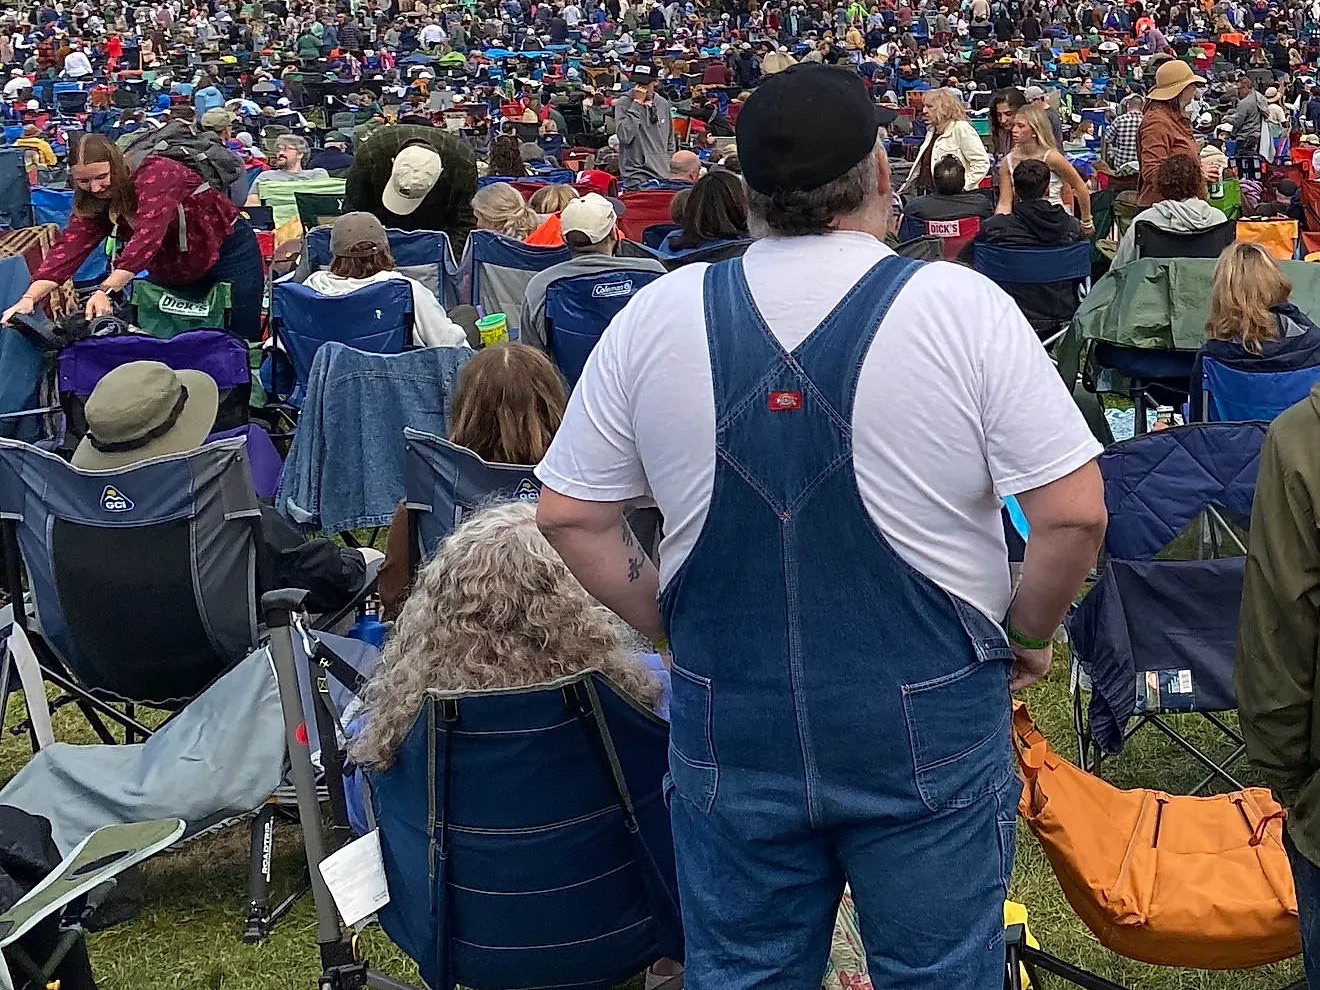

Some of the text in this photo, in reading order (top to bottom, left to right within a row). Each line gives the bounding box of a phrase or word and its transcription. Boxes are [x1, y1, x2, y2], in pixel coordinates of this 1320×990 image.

[930, 223, 958, 234] DICK'S
[595, 283, 624, 294] Coleman
[105, 501, 127, 510] GCI
[262, 822, 270, 874] ROADTRIP
